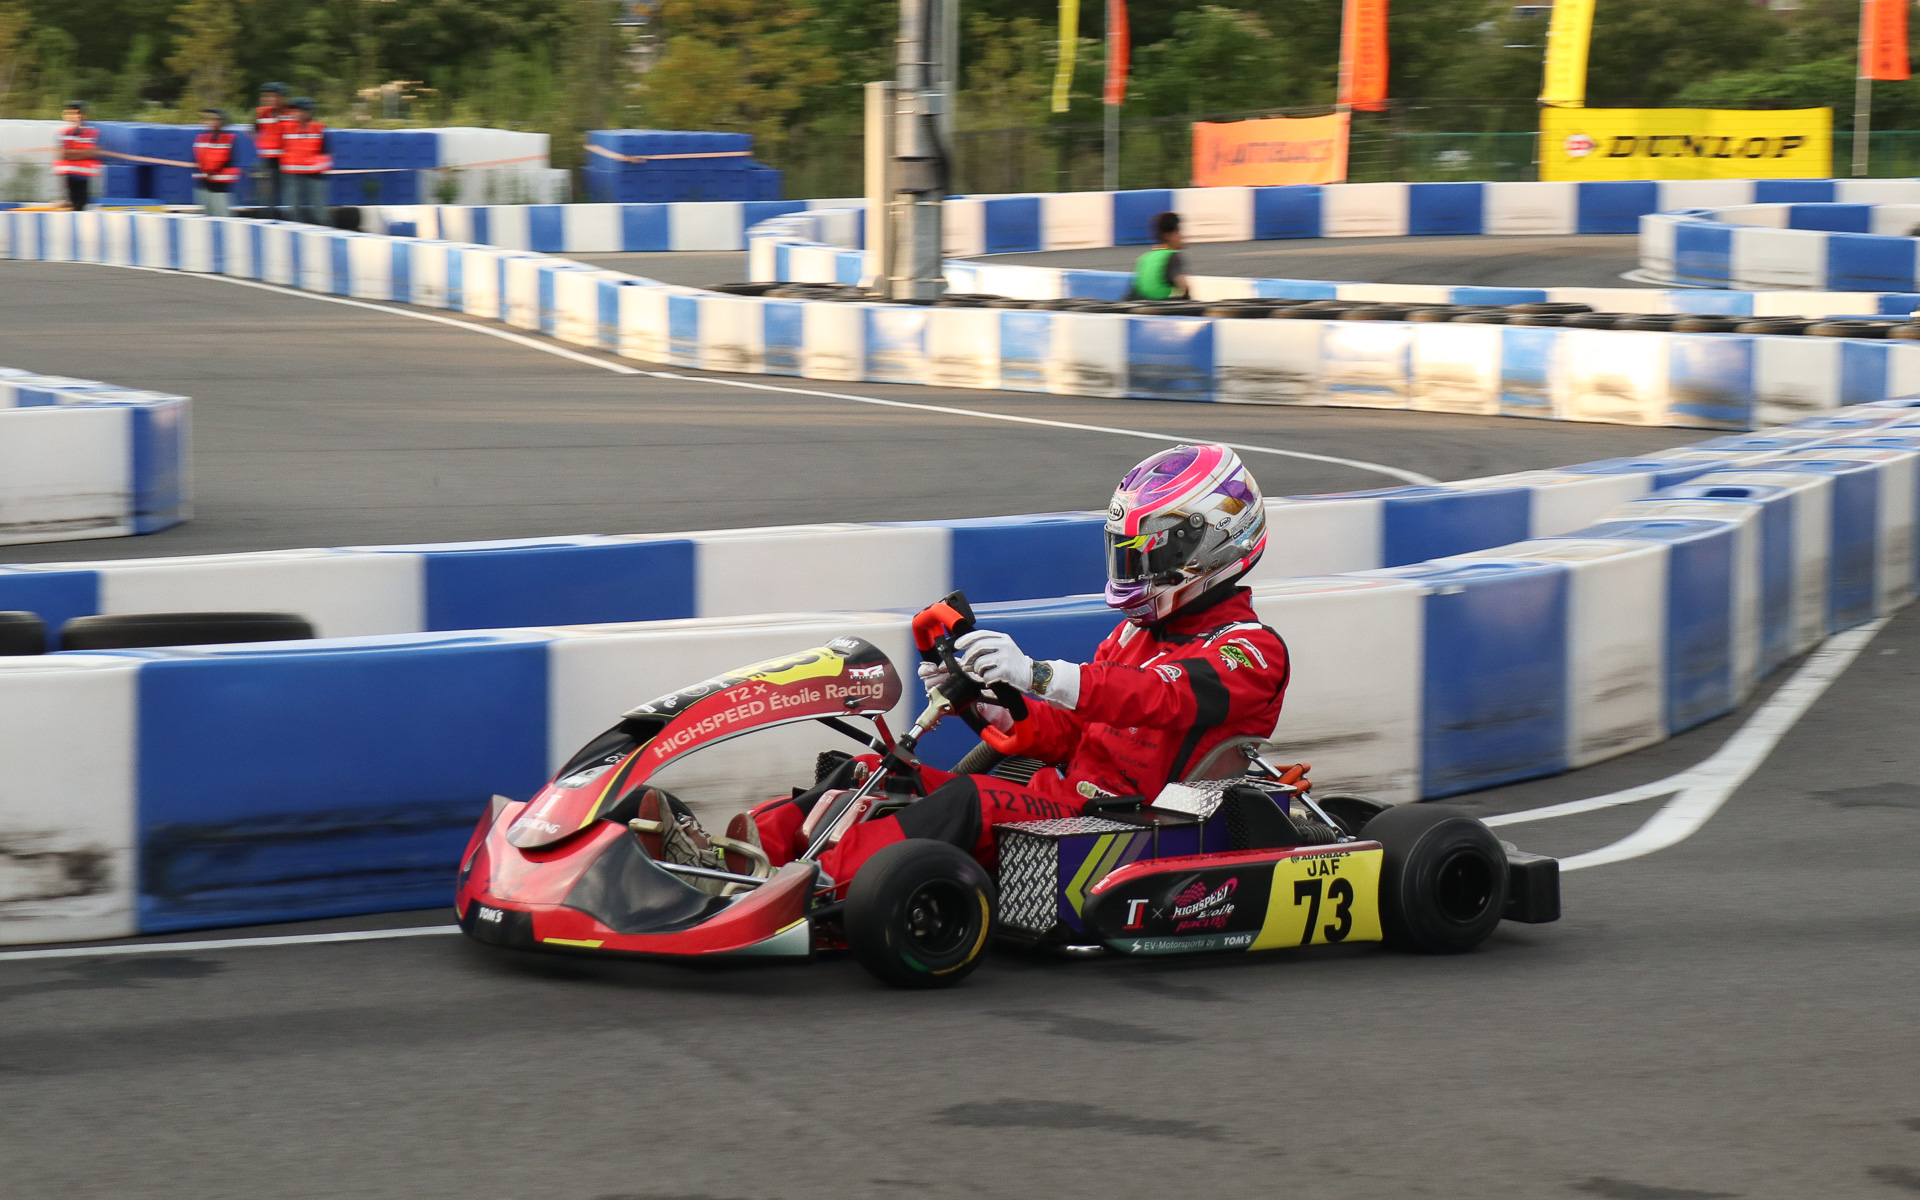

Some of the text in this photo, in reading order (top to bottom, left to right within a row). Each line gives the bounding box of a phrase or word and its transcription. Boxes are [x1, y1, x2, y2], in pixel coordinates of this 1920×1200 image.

[1603, 134, 1807, 159] DUNLOP
[725, 686, 751, 703] T2
[654, 700, 766, 759] HIGHSPEED
[769, 687, 821, 711] Étoile
[825, 681, 884, 699] Racing
[983, 789, 1020, 812] T2
[1300, 851, 1351, 861] AUTOBACS
[1307, 859, 1340, 877] JAF
[479, 907, 503, 922] TOM'S
[1293, 877, 1354, 945] 73
[1144, 934, 1252, 950] EV-Motorsports by TOM'S
